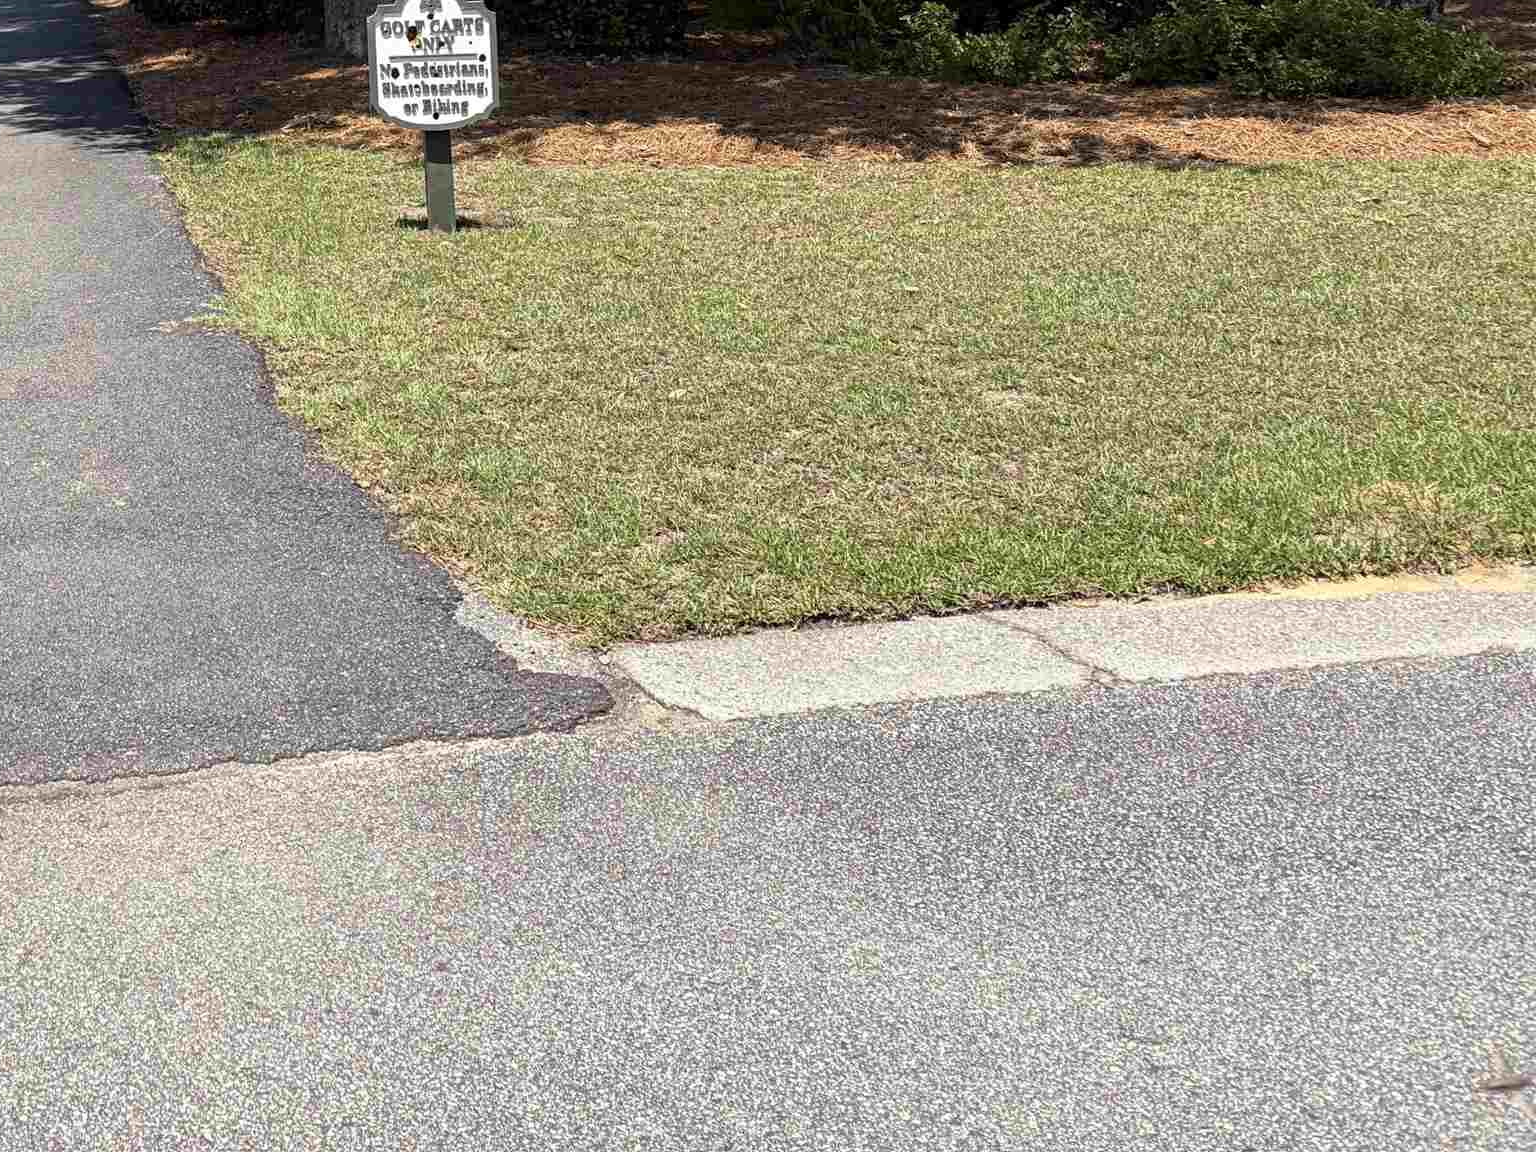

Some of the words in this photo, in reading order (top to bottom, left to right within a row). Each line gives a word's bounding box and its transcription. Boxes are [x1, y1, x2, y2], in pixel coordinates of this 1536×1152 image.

[430, 17, 484, 37] CARTS
[380, 63, 400, 80] No
[404, 103, 419, 117] or
